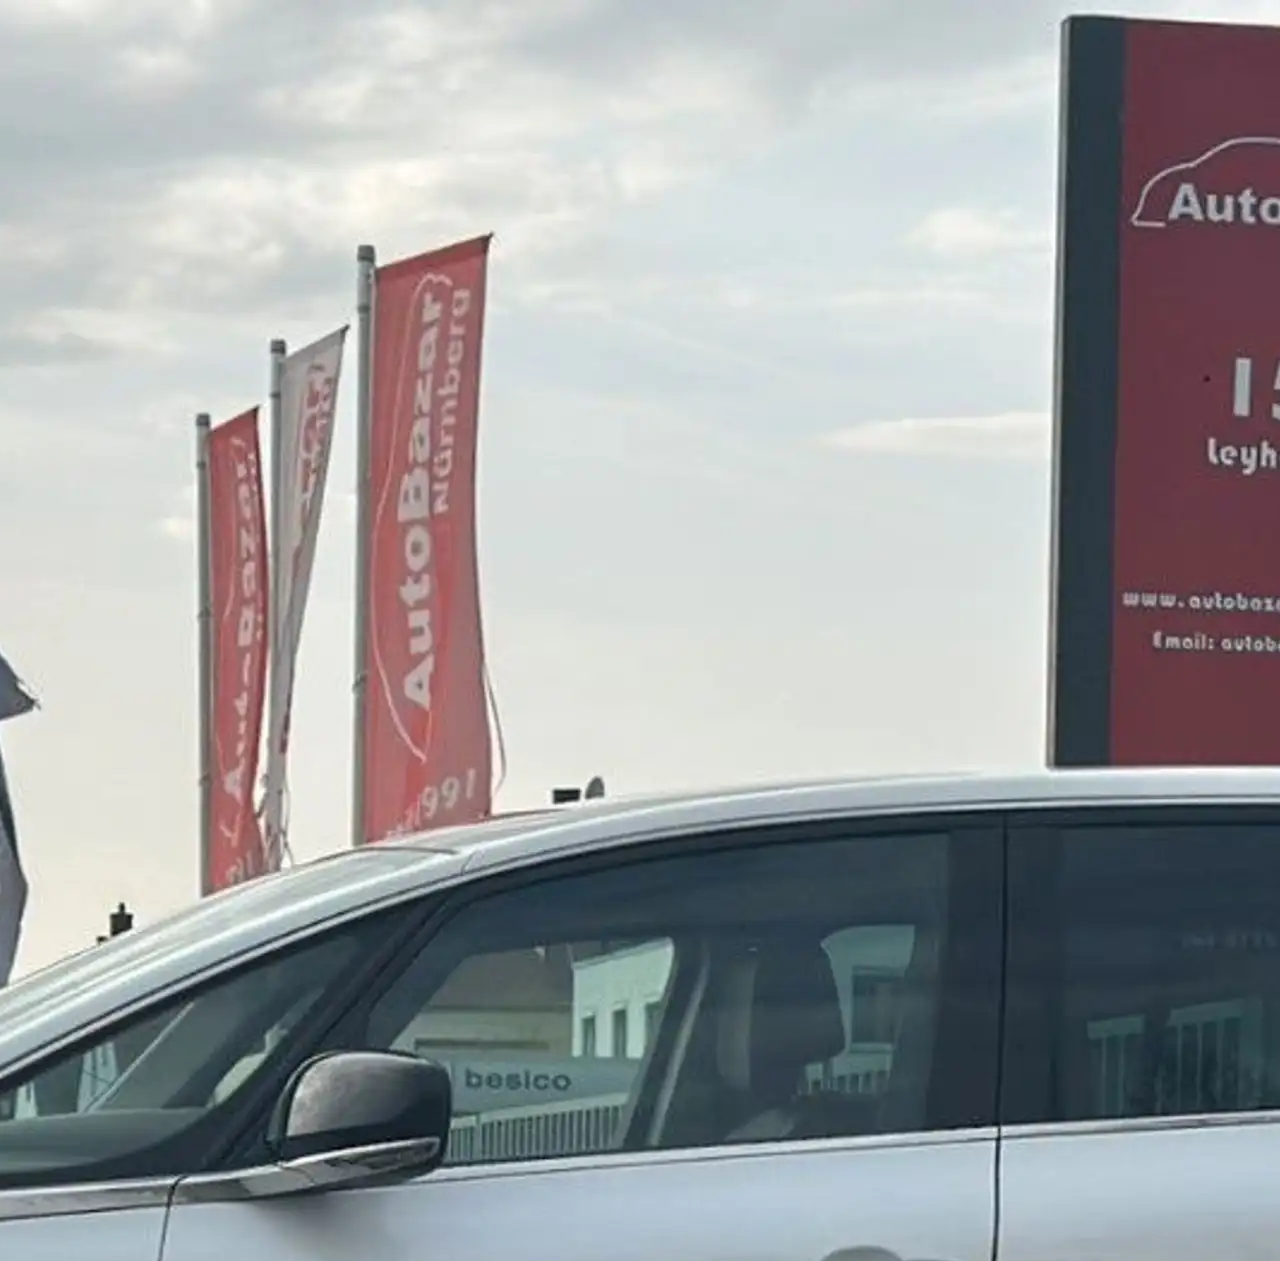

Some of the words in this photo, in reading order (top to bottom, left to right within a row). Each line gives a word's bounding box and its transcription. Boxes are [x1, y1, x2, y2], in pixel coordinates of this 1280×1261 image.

[397, 291, 443, 708] AutoBazar
[432, 288, 471, 515] Nürnberg
[1152, 630, 1215, 650] Email:
